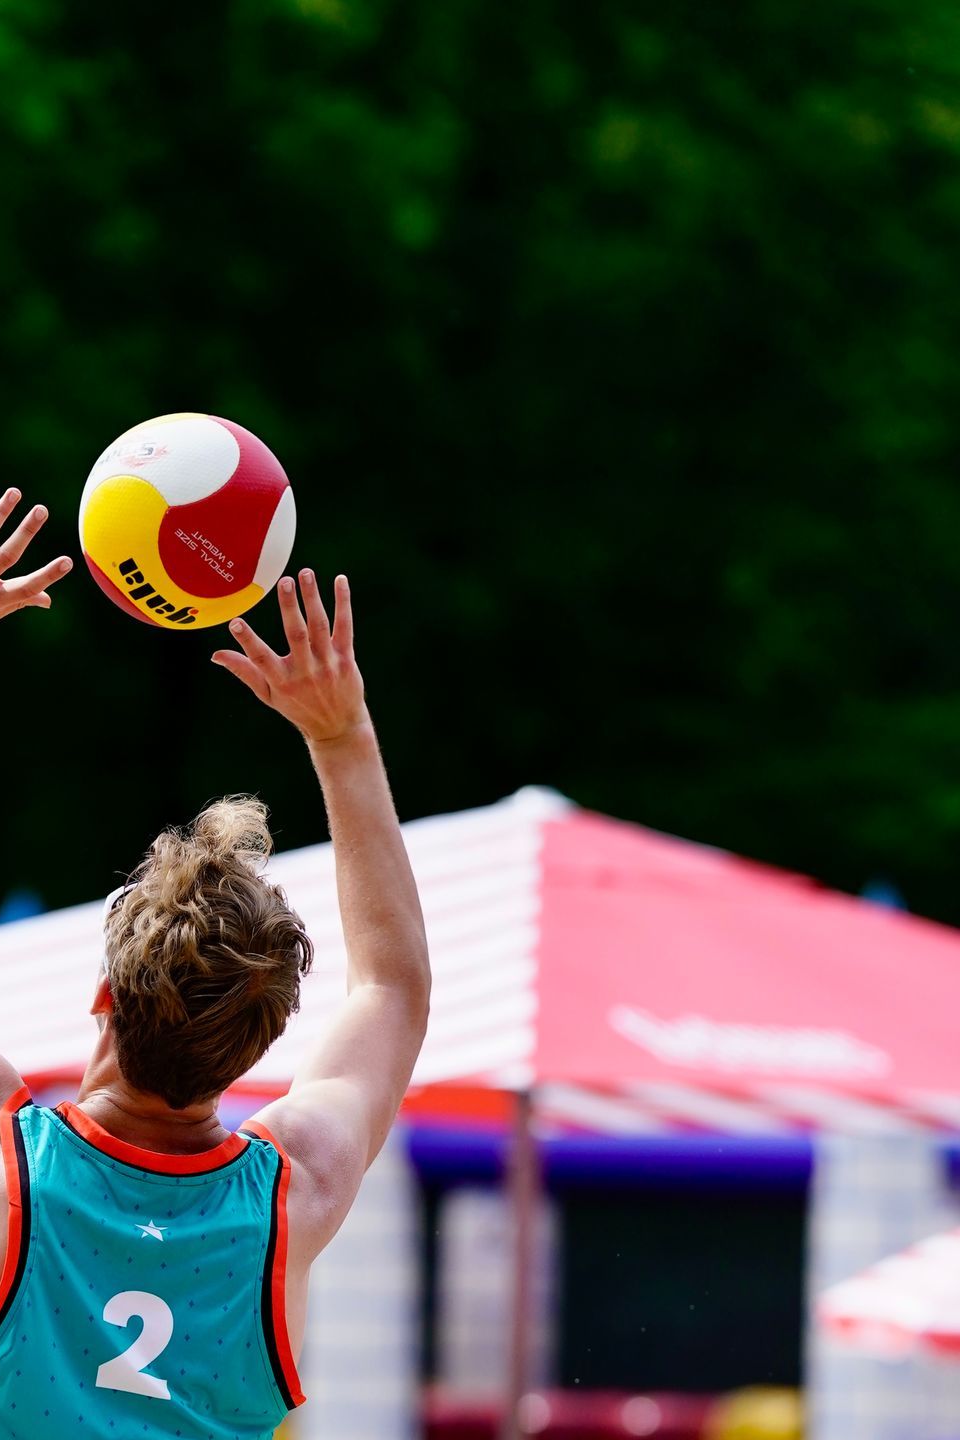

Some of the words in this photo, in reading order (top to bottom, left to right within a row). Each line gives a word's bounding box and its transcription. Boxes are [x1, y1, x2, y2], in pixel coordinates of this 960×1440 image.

[174, 528, 199, 551] SIZE
[191, 531, 227, 563] WEIGHT
[200, 548, 235, 583] OFFICIAL
[118, 558, 200, 625] gala
[95, 1290, 174, 1400] 2
